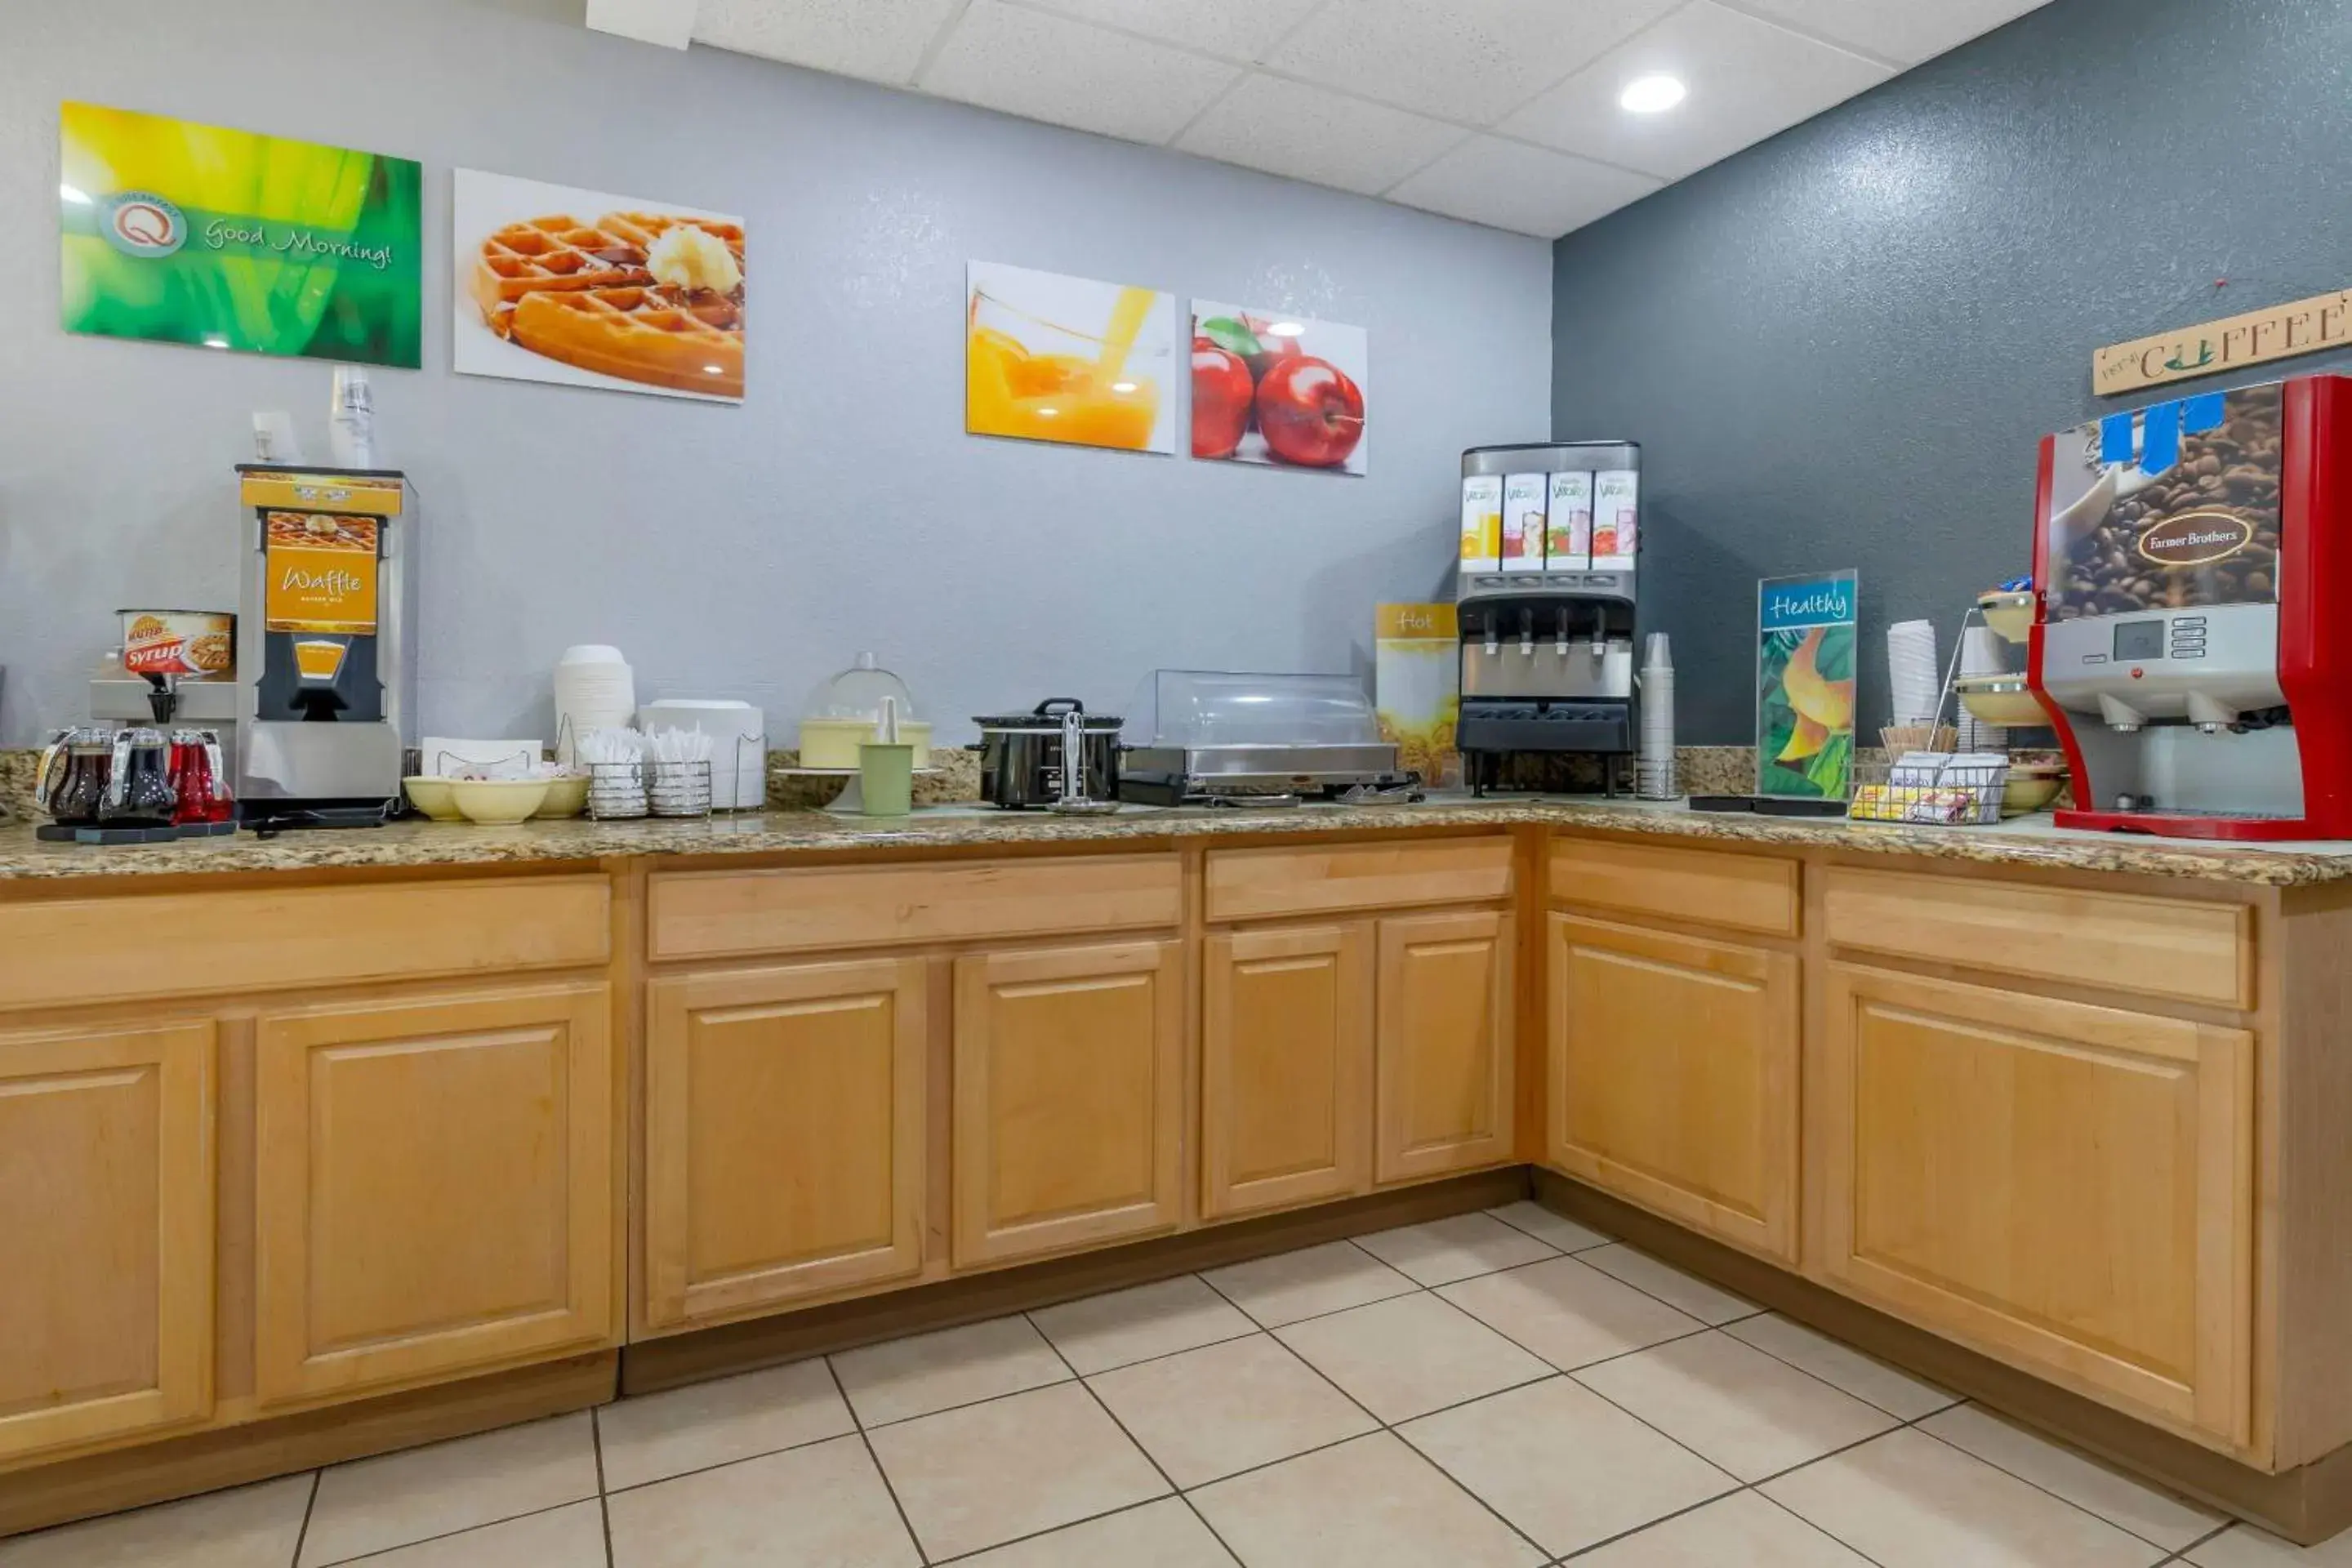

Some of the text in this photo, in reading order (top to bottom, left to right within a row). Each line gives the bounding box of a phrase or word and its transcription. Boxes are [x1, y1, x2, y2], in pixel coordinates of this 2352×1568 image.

[206, 219, 392, 270] Good Morning!
[2150, 530, 2238, 550] Farmer Brothers
[283, 567, 361, 596] Waffle
[1769, 592, 1846, 619] Healthy
[1395, 612, 1433, 632] Hot
